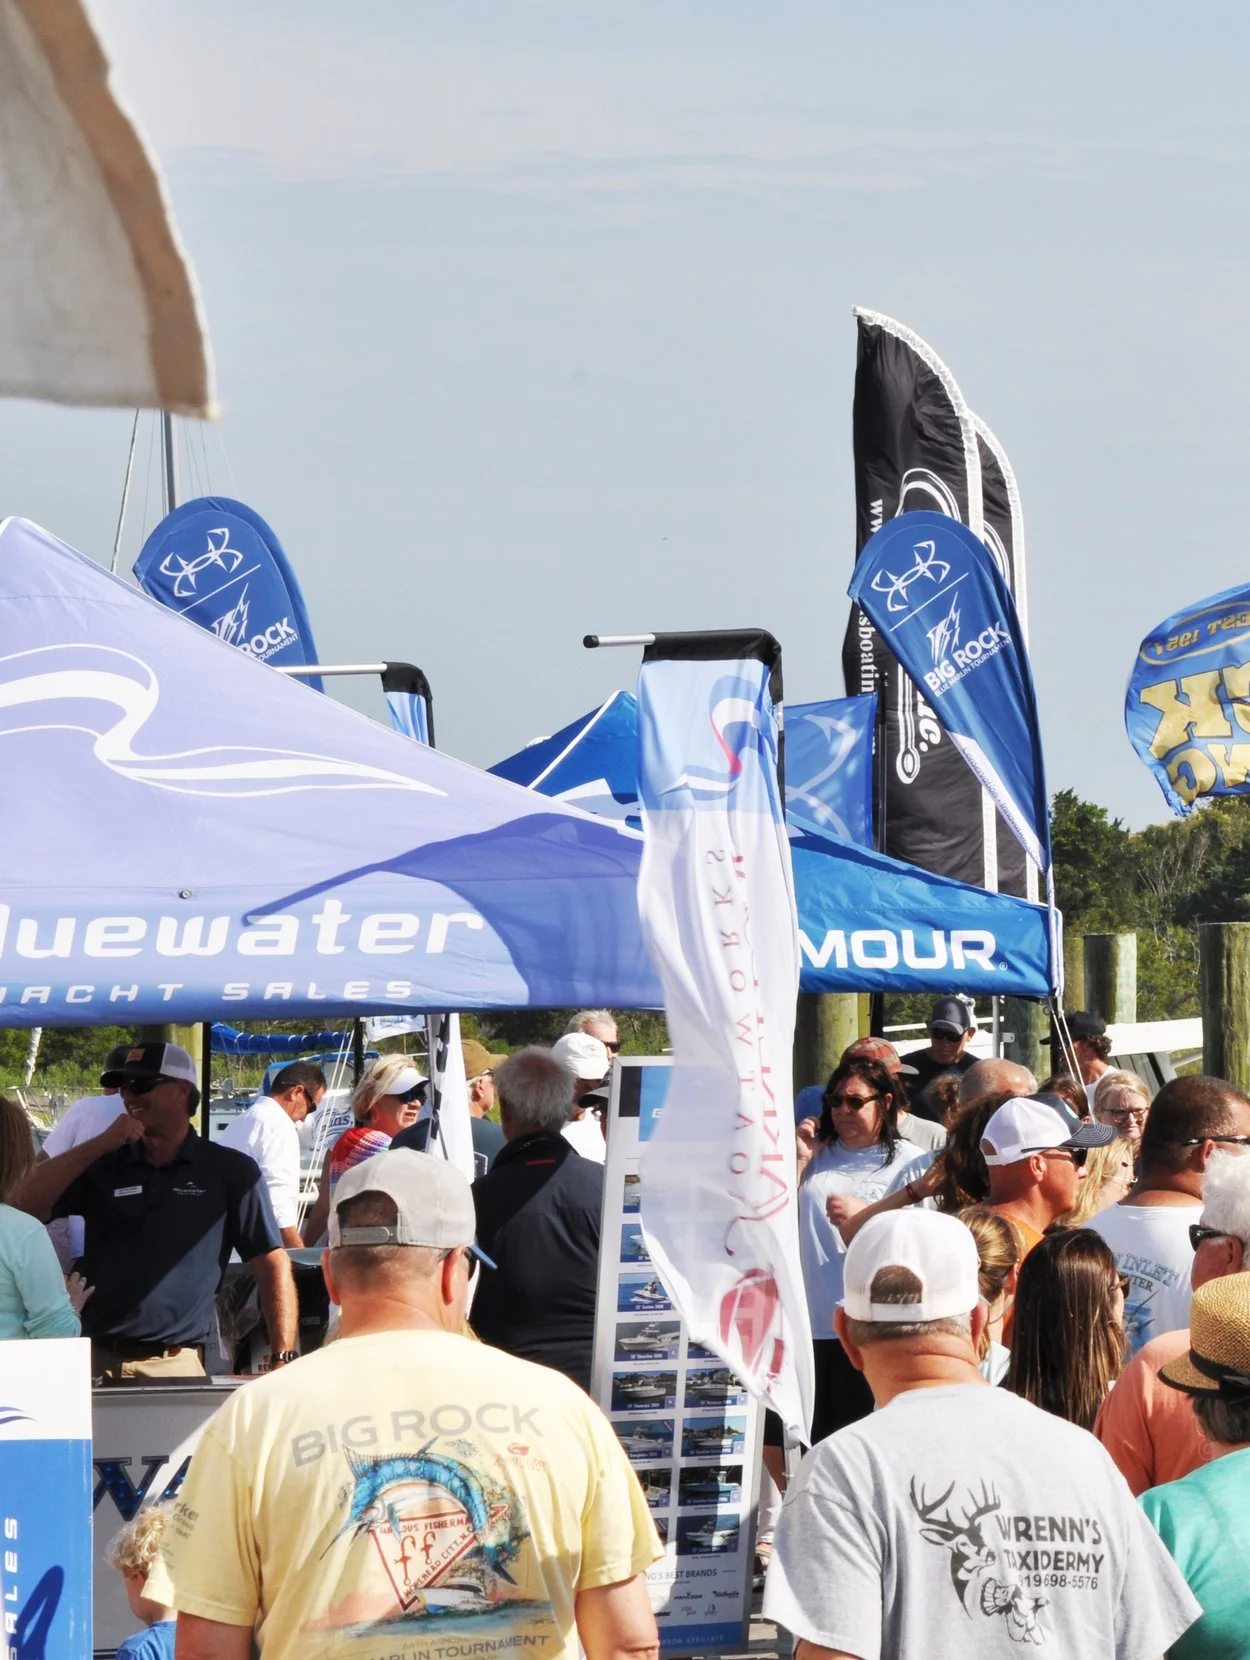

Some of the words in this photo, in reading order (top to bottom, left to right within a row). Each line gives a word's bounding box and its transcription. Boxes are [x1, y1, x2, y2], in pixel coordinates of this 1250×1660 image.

[257, 633, 299, 661] OURNAMENT
[858, 611, 881, 693] sboatin
[923, 659, 956, 692] BIG
[952, 621, 1009, 669] ROCK
[222, 979, 414, 1001] SALES
[291, 1415, 378, 1468] BIG
[390, 1402, 544, 1442] ROCK
[995, 1514, 1103, 1545] WRENN'S
[5, 1517, 18, 1660] SALES
[685, 1568, 718, 1579] BRANDS
[434, 1635, 549, 1660] TOURNAMENT
